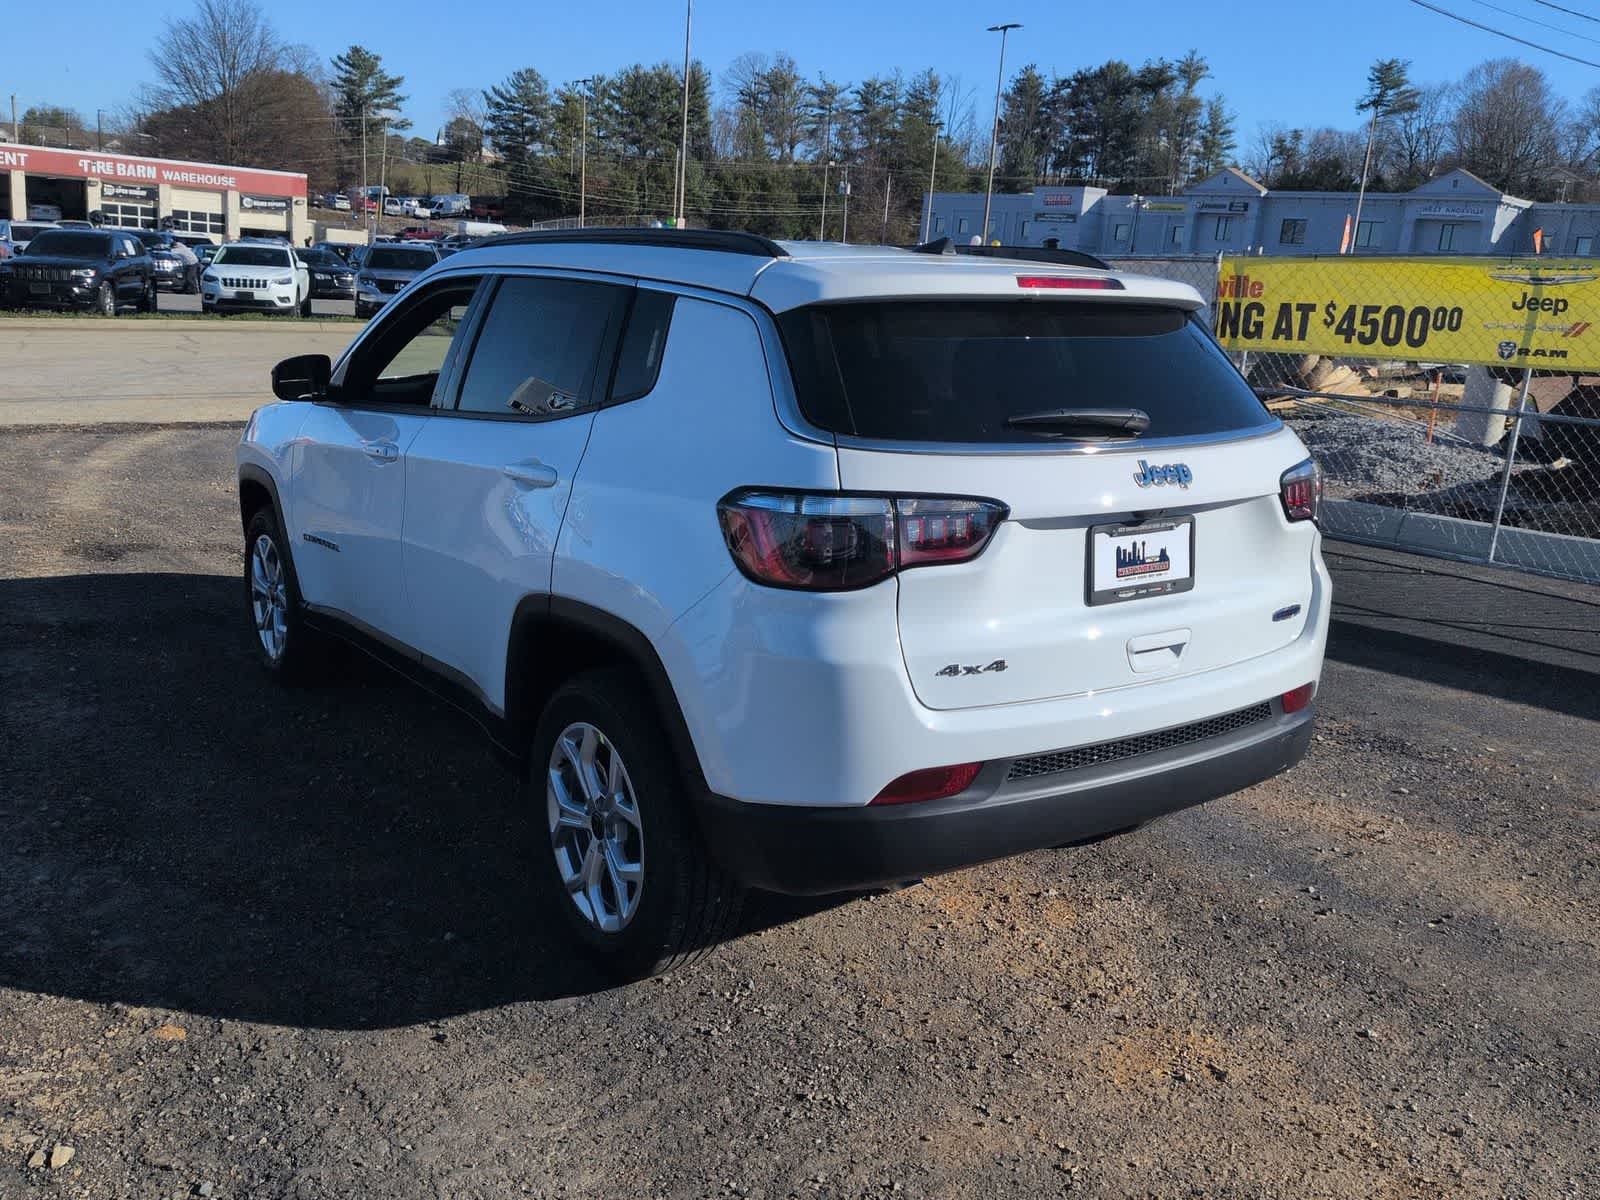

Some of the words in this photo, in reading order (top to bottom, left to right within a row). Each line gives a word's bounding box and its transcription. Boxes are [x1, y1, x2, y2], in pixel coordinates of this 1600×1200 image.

[117, 162, 157, 178] BARN
[162, 170, 236, 187] WAREHOUSE
[1512, 292, 1568, 316] Jeep
[1272, 303, 1316, 341] AT
[1517, 348, 1568, 358] RAM
[1133, 459, 1193, 490] Jeep
[936, 659, 1008, 678] 4x4
